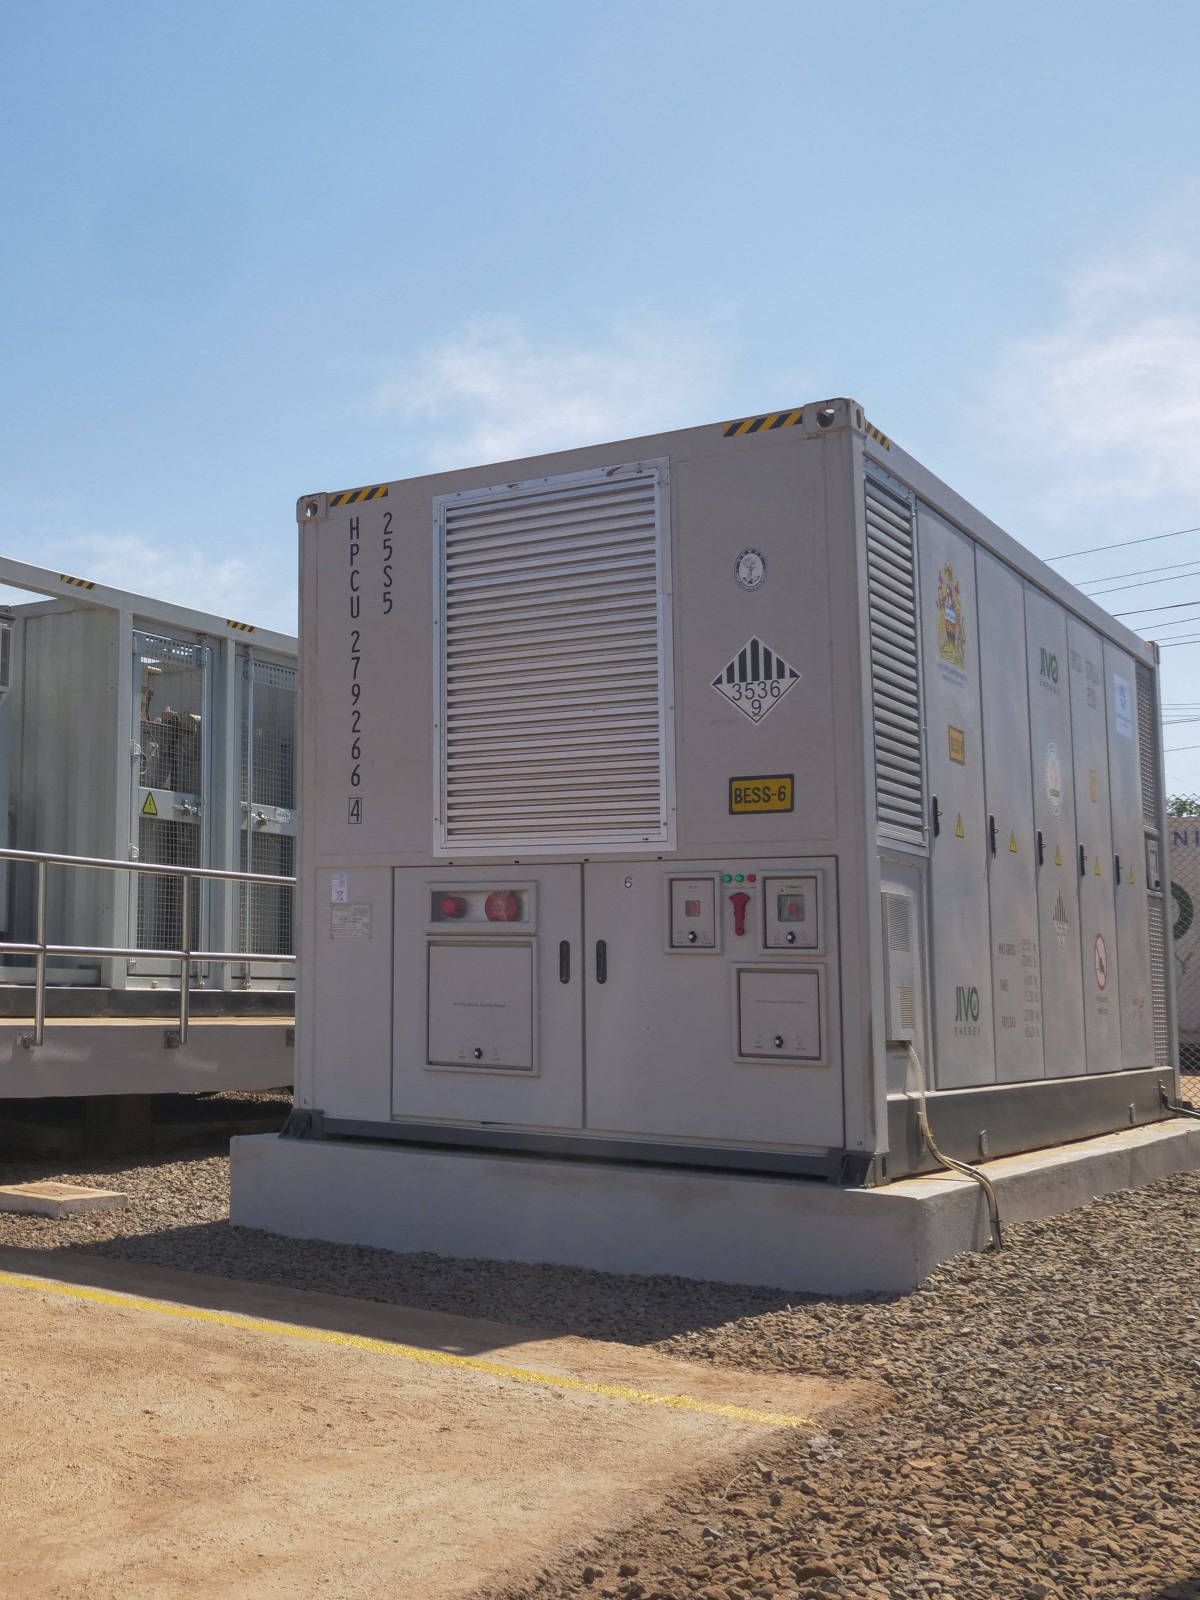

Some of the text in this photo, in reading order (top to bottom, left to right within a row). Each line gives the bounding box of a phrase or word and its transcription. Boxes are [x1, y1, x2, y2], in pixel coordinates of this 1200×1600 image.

[382, 512, 394, 616] 25S5
[348, 517, 362, 824] HPCU 279266 4
[731, 680, 781, 702] 3536
[751, 699, 762, 716] 9
[733, 784, 787, 804] BESS-6
[624, 876, 633, 889] 6
[955, 986, 980, 1022] JIVO
